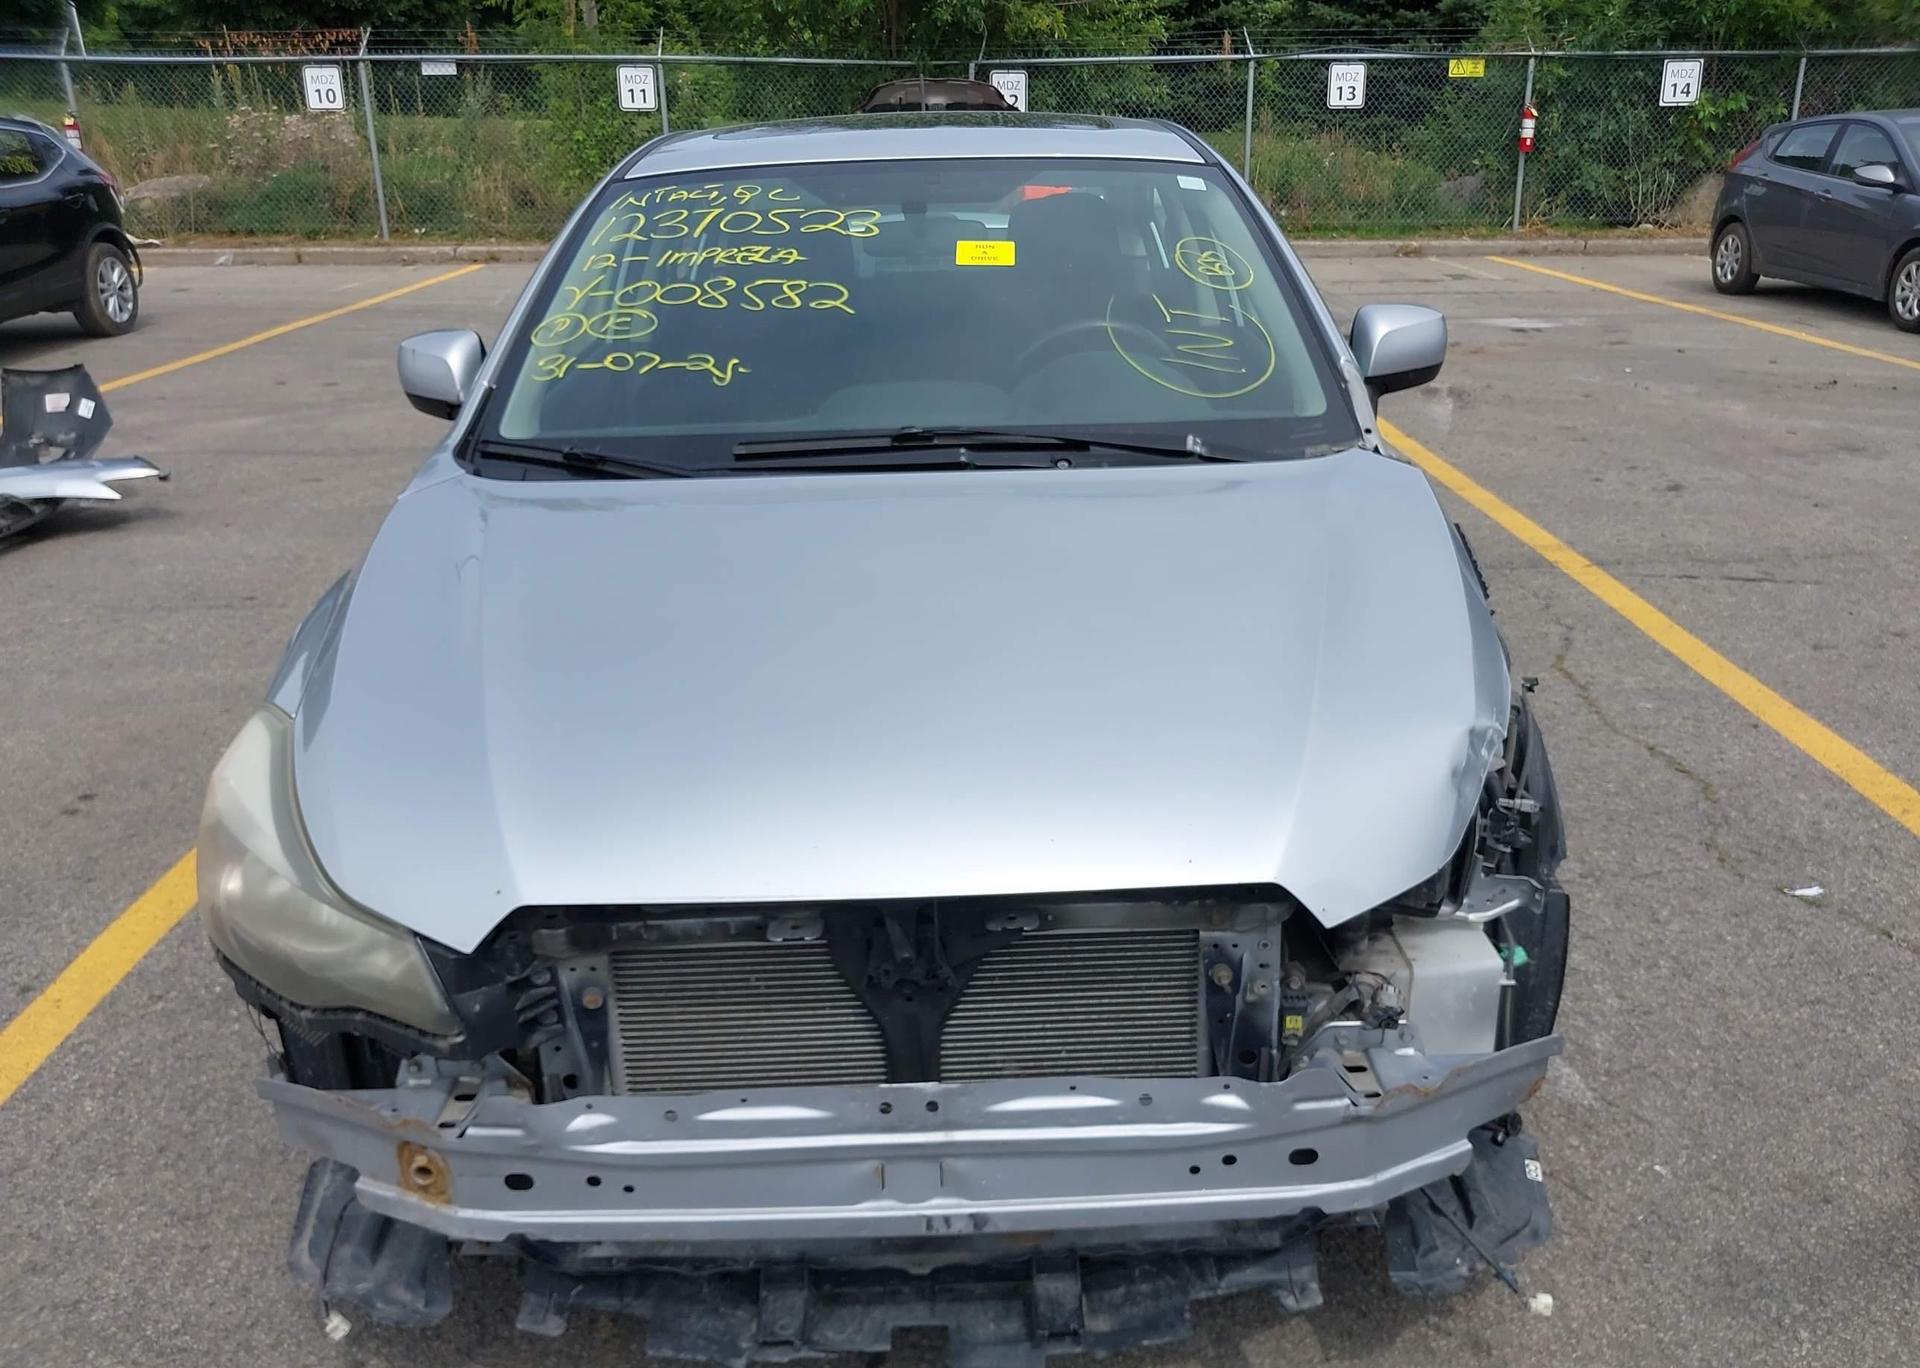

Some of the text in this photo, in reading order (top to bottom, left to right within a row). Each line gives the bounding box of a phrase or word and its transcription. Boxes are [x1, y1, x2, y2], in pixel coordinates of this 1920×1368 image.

[310, 74, 334, 85] MDZ
[624, 74, 649, 85] MDZ
[1335, 71, 1360, 82] MDZ
[1670, 68, 1695, 79] MDZ
[996, 80, 1021, 91] MDZ
[1670, 82, 1691, 98] 14
[314, 88, 337, 104] 10
[627, 88, 647, 104] 11
[1336, 85, 1357, 101] 13
[592, 207, 882, 247] 12370523
